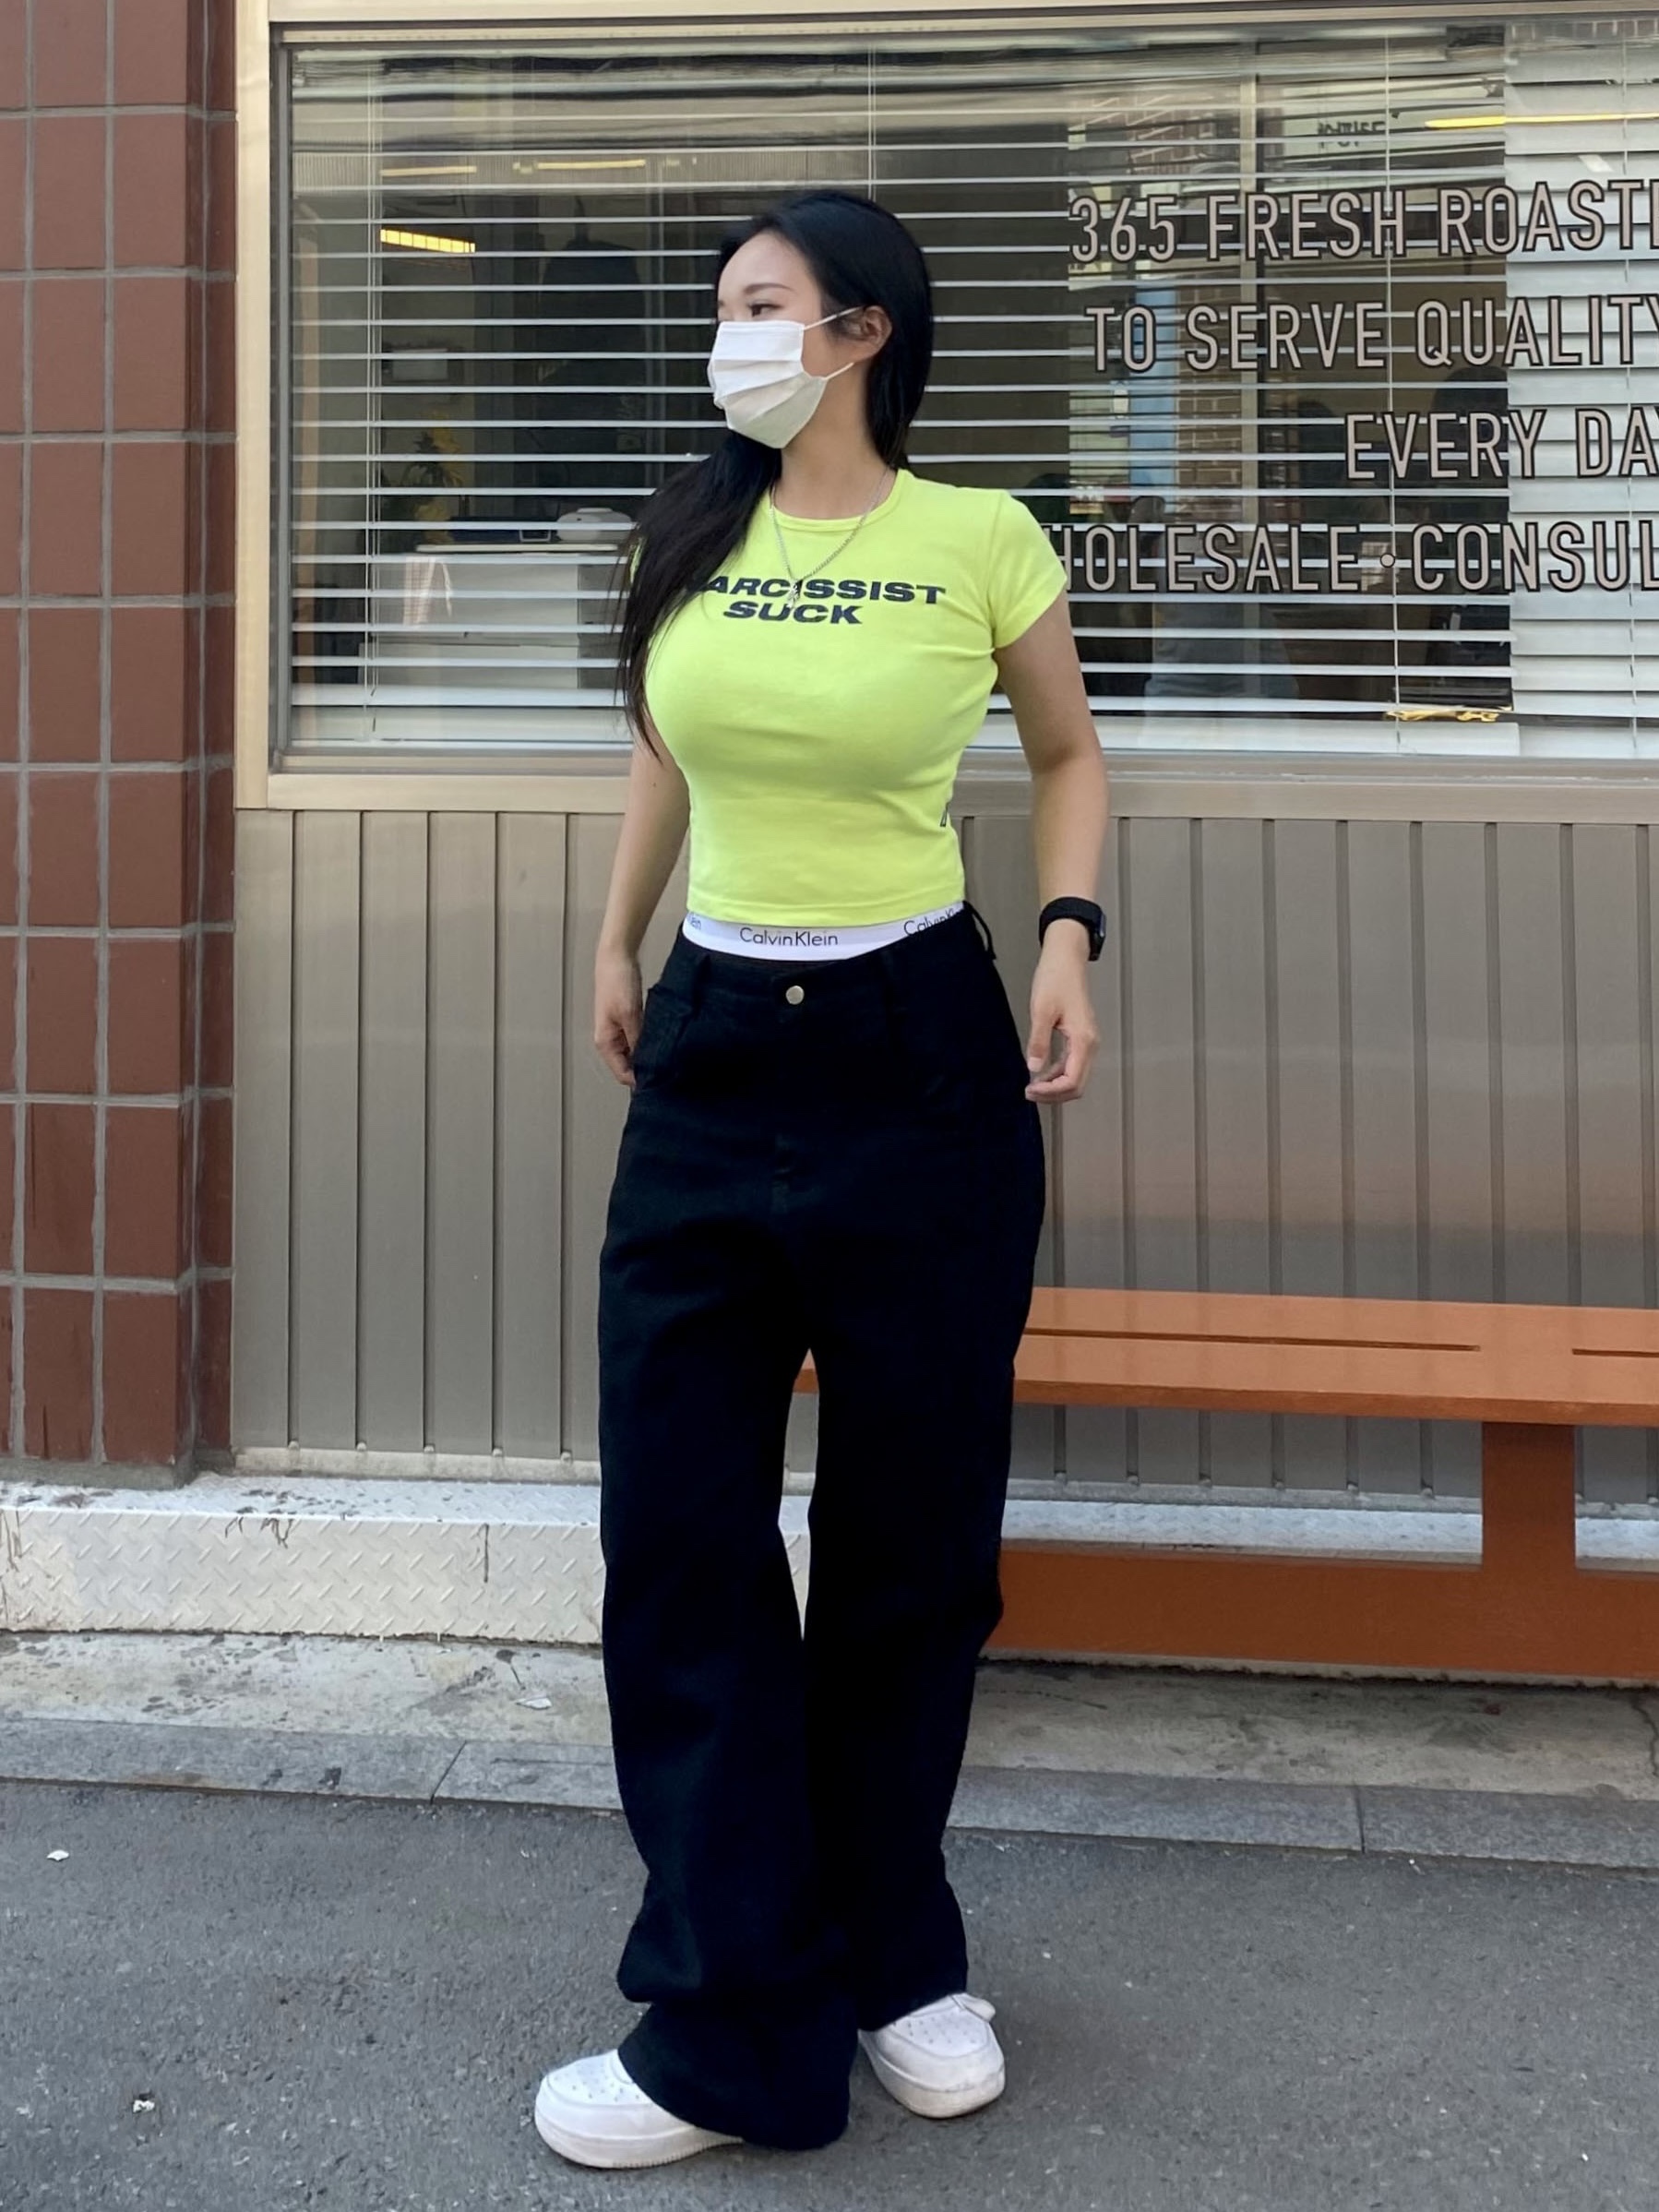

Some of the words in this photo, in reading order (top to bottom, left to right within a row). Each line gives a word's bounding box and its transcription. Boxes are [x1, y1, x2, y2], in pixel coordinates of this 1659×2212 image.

[1068, 194, 1178, 264] 365
[1207, 188, 1406, 260] FRESH
[1084, 304, 1156, 372] TO
[1185, 300, 1386, 370] SERVE
[1345, 408, 1546, 480] EVERY
[1575, 406, 1659, 478] DA
[707, 575, 946, 604] ARCISSIST
[1041, 523, 1361, 593] HOLESALE
[723, 601, 862, 625] SUCK
[740, 927, 838, 947] CalvinKlein
